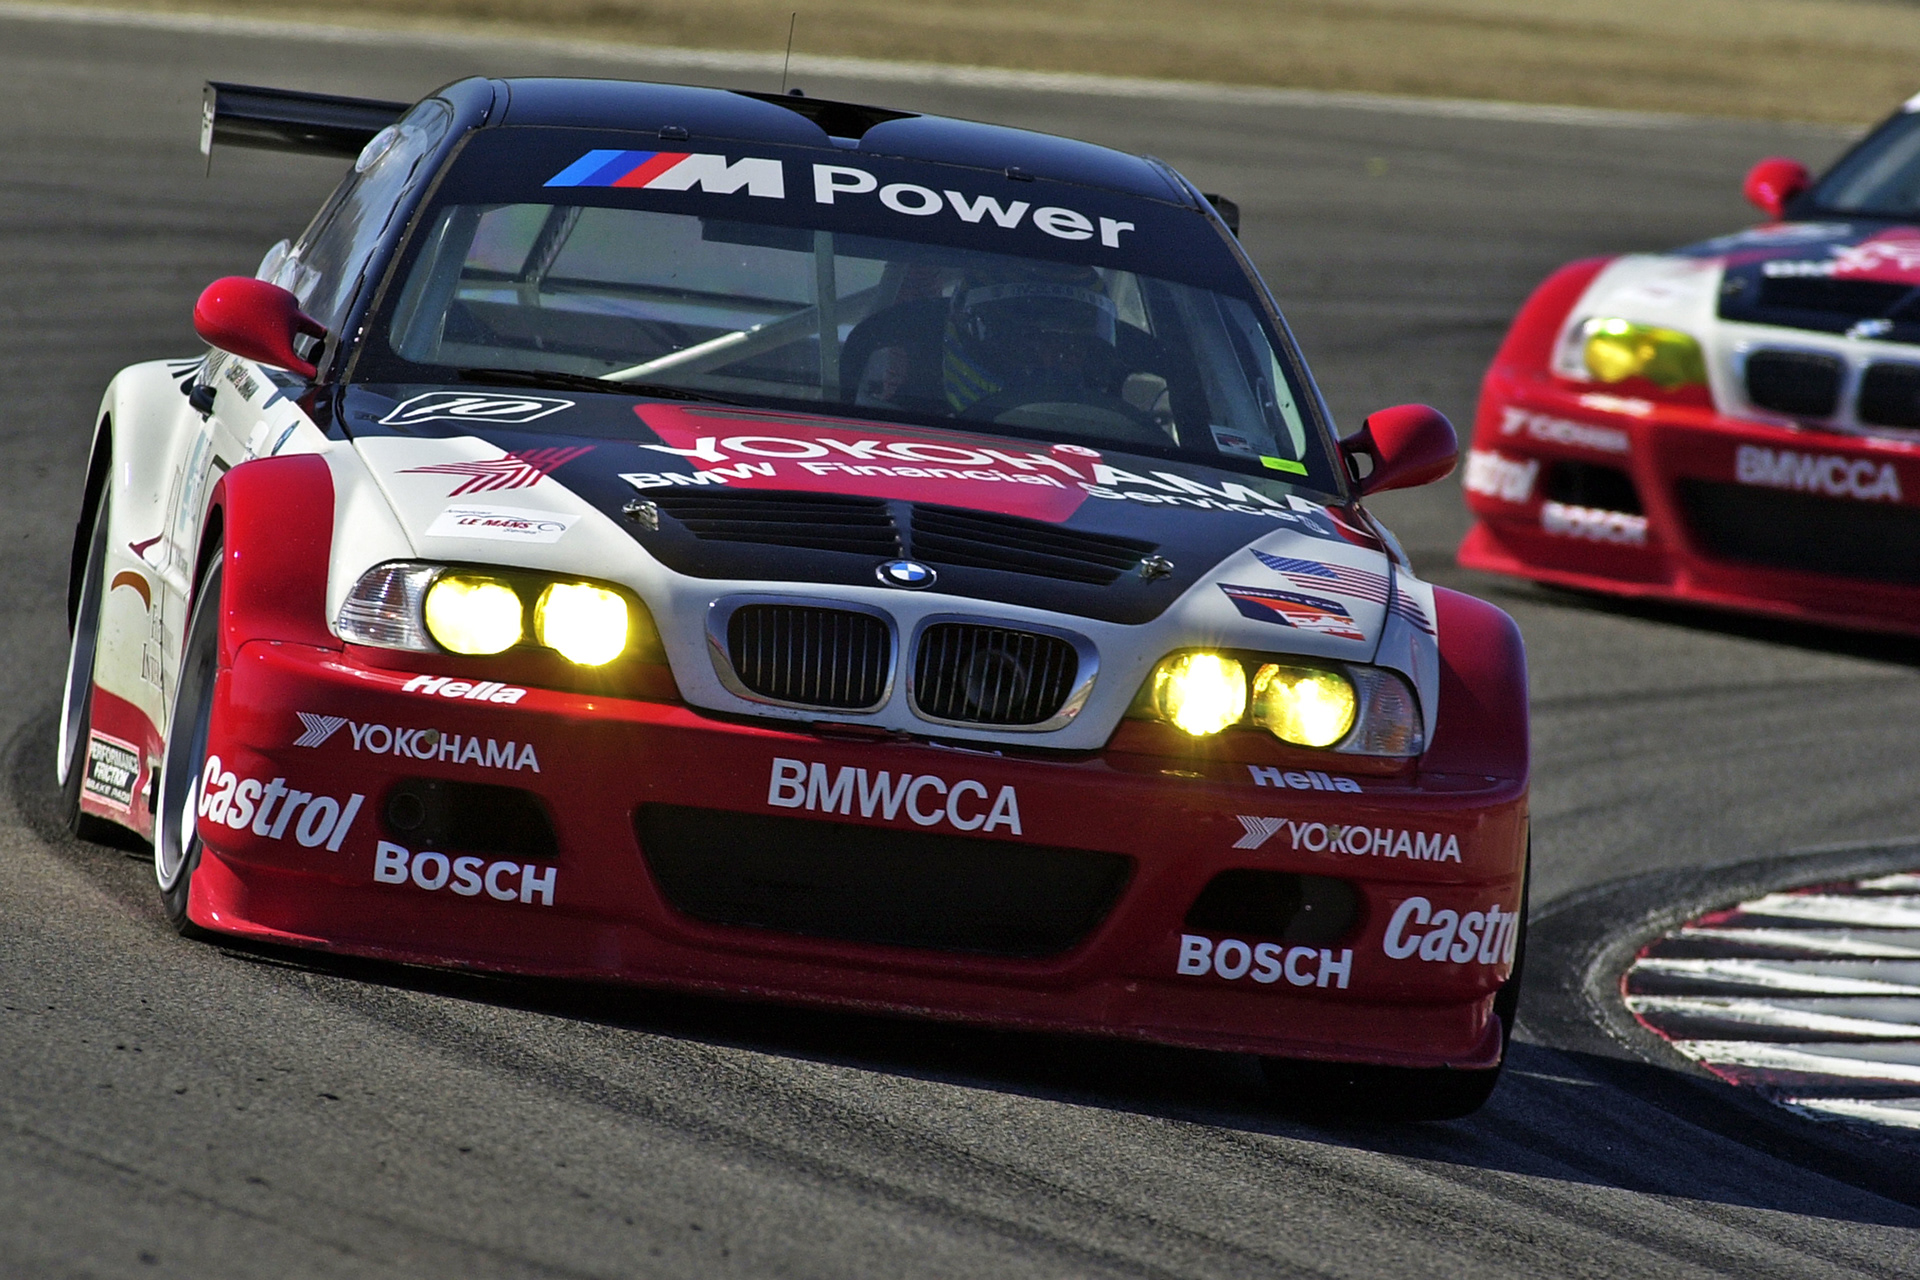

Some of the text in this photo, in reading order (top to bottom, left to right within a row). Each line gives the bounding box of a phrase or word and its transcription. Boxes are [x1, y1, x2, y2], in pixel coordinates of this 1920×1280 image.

[643, 153, 1135, 249] M Power
[618, 461, 1330, 535] BMW Financial Services
[639, 436, 1327, 515] YOKOHAMA
[1736, 444, 1902, 500] BMWCCA
[458, 517, 534, 530] LE MANS
[401, 674, 528, 704] Hella
[91, 740, 139, 776] PERFORMANCE
[94, 761, 130, 788] FRICTION
[348, 720, 541, 774] YOKOHAMA
[198, 755, 365, 853] Castrol
[767, 757, 1024, 836] BMWCCA
[1246, 764, 1364, 794] Hella
[1287, 820, 1463, 864] YOKOHAMA
[373, 840, 558, 906] BOSCH
[1382, 896, 1519, 966] Castro
[1176, 933, 1354, 989] BOSCH
